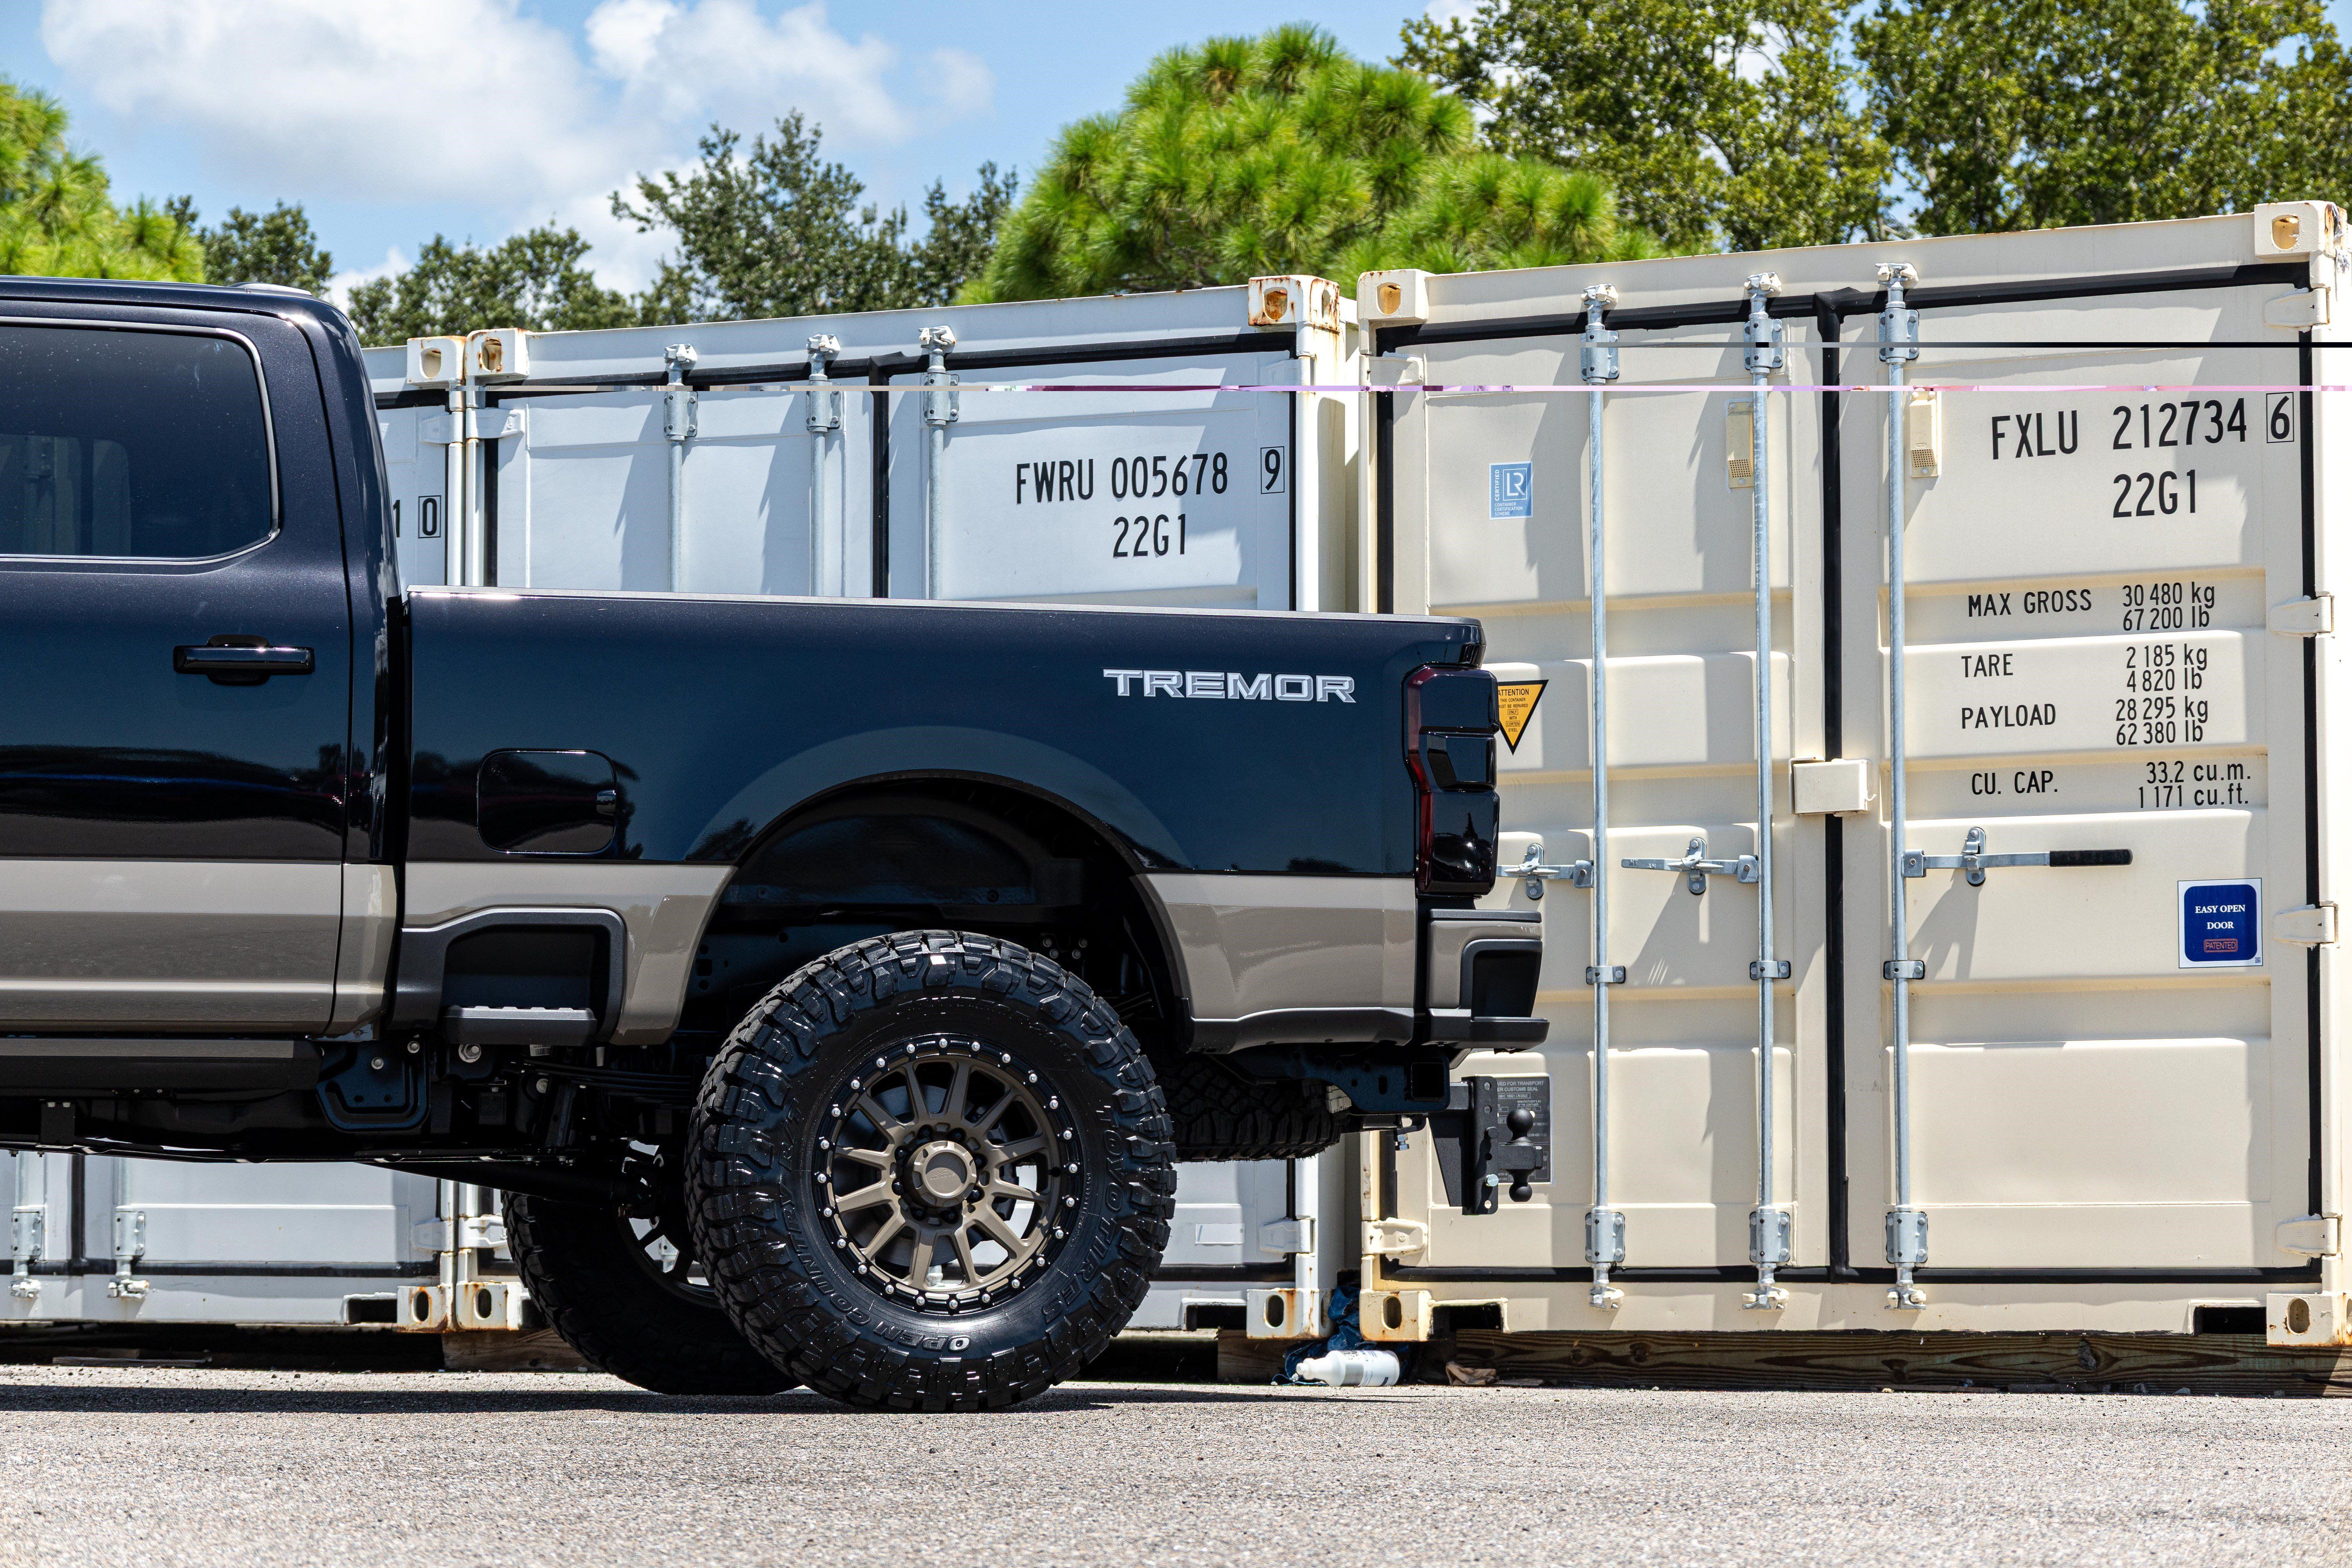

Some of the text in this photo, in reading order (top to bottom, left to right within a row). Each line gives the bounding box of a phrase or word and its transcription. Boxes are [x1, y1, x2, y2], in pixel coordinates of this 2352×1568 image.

[1992, 396, 2290, 459] FXLU 212734 6
[1017, 449, 1280, 504] FWRU 005678 9
[1507, 472, 1525, 496] LR
[2113, 470, 2195, 518] 22G1
[1113, 514, 1185, 557] 22G1
[1969, 593, 2011, 617] MAX
[2024, 589, 2091, 613] GROSS
[2192, 581, 2214, 608] kg
[2192, 606, 2209, 628] lb
[1961, 654, 2013, 677] TARE
[2185, 644, 2207, 670] kg
[1103, 669, 1356, 703] TREMOR
[2185, 667, 2202, 689] lb
[1962, 704, 2056, 729] PAYLOAD
[2185, 696, 2207, 723] kg
[2185, 720, 2203, 742] lb
[1972, 761, 2250, 795] CU. CAP. 33.2 cu.m.
[2194, 783, 2248, 806] cu.ft.
[2195, 904, 2245, 913] EASY OPEN
[1096, 1104, 1124, 1212] TOYO
[779, 1173, 871, 1325] COUNTRY
[1042, 1217, 1118, 1324] TIRES
[873, 1321, 971, 1352] OPEN
